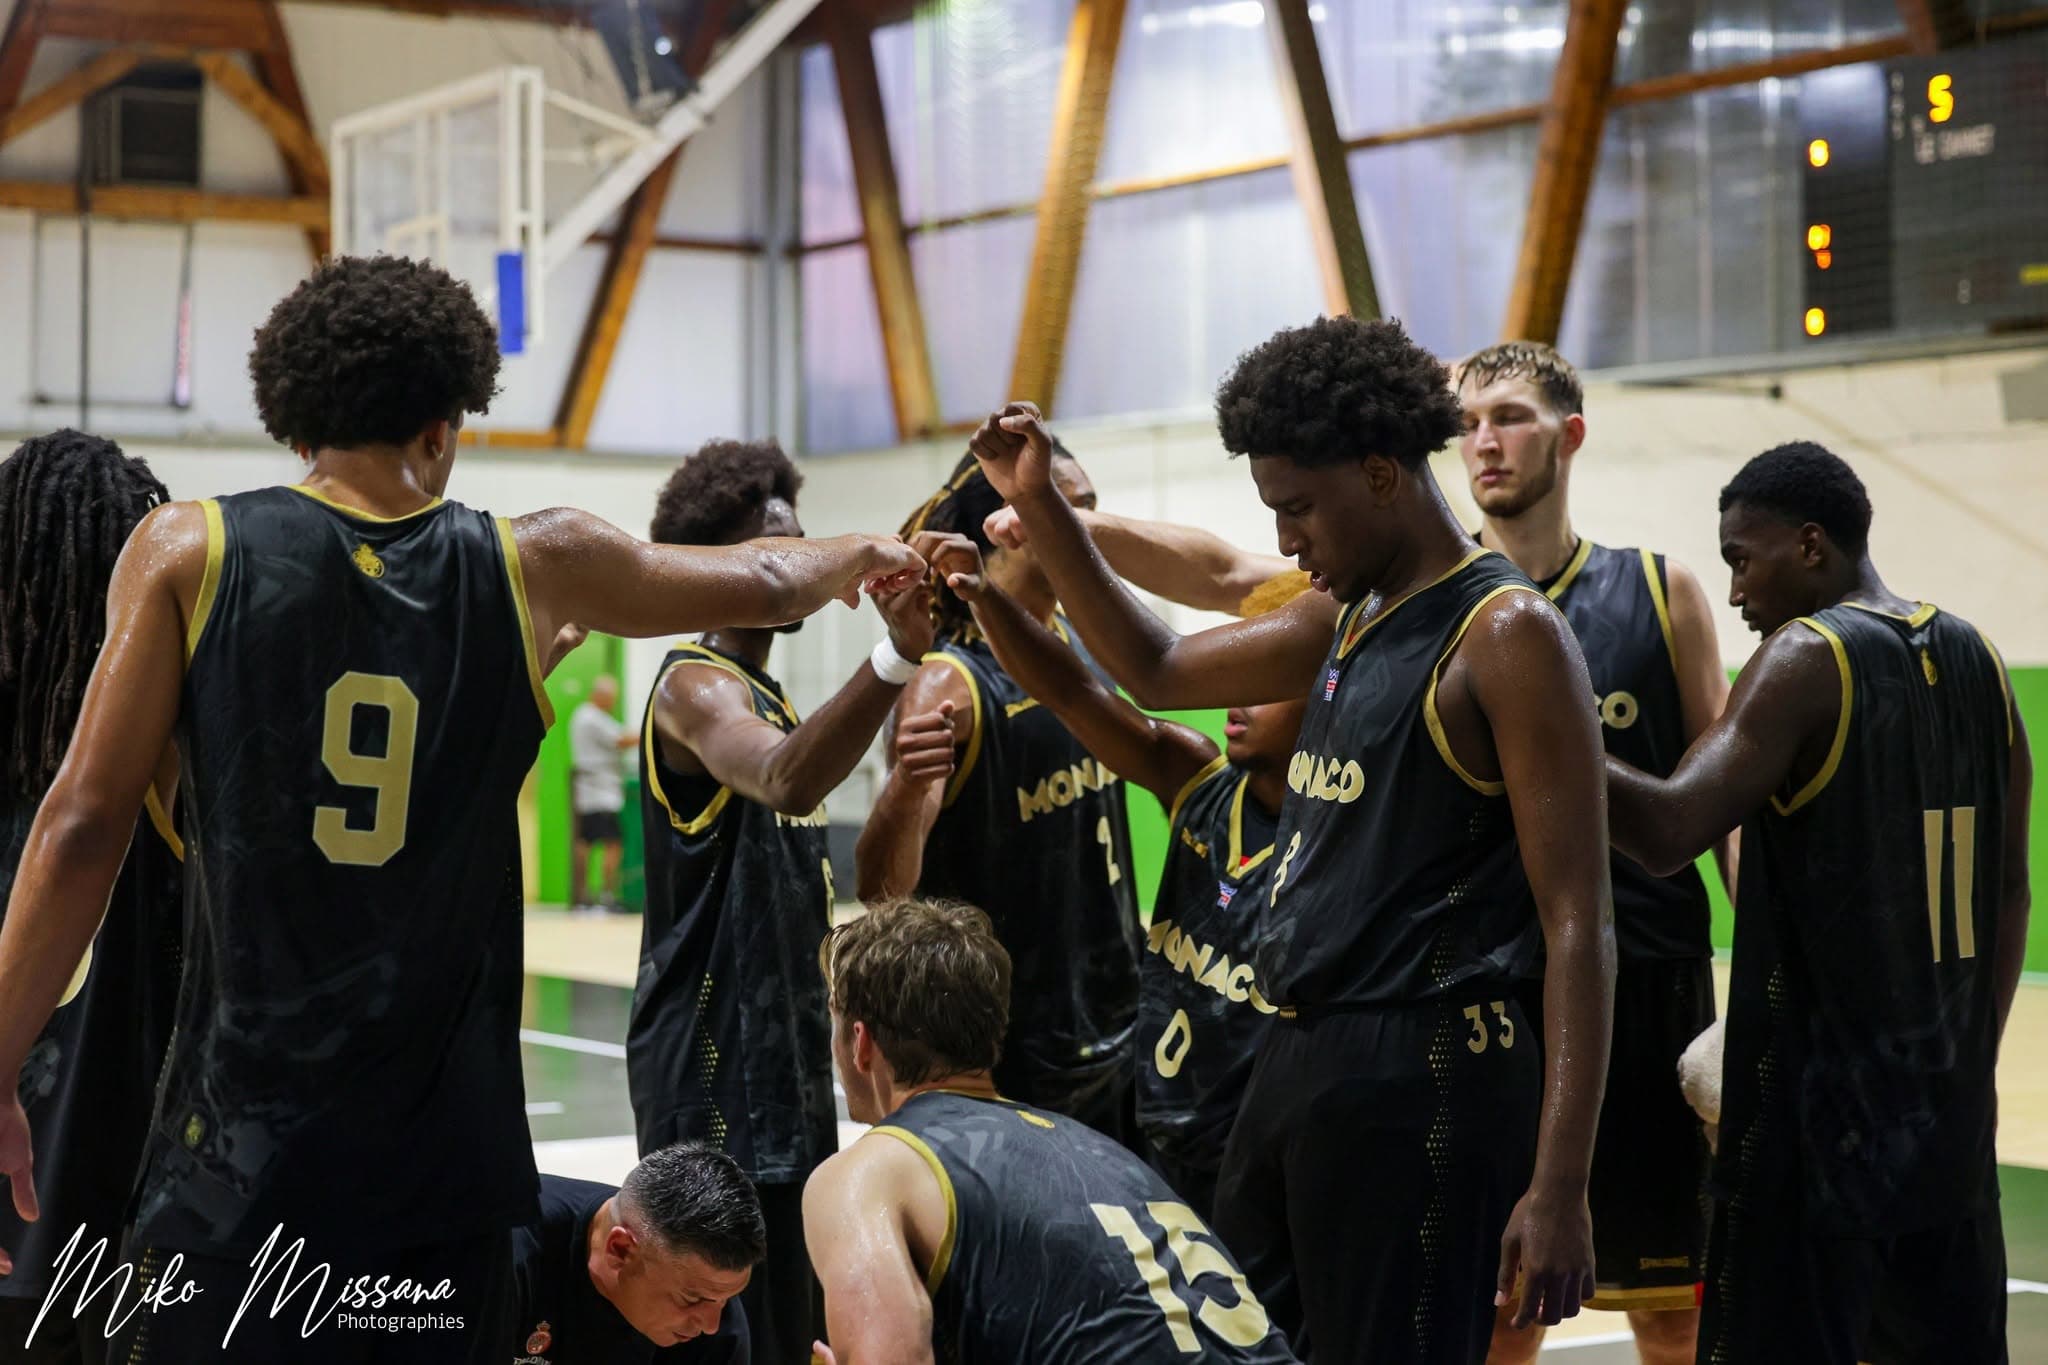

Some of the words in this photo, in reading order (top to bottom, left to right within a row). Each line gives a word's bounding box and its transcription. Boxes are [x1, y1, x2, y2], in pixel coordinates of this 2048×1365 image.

[312, 671, 419, 867] 9
[1017, 757, 1119, 823] MONA
[1287, 750, 1365, 803] ONACO
[1923, 806, 1976, 963] 11
[1155, 1008, 1193, 1079] 0
[1463, 1000, 1514, 1054] 33
[1090, 1201, 1270, 1353] 15
